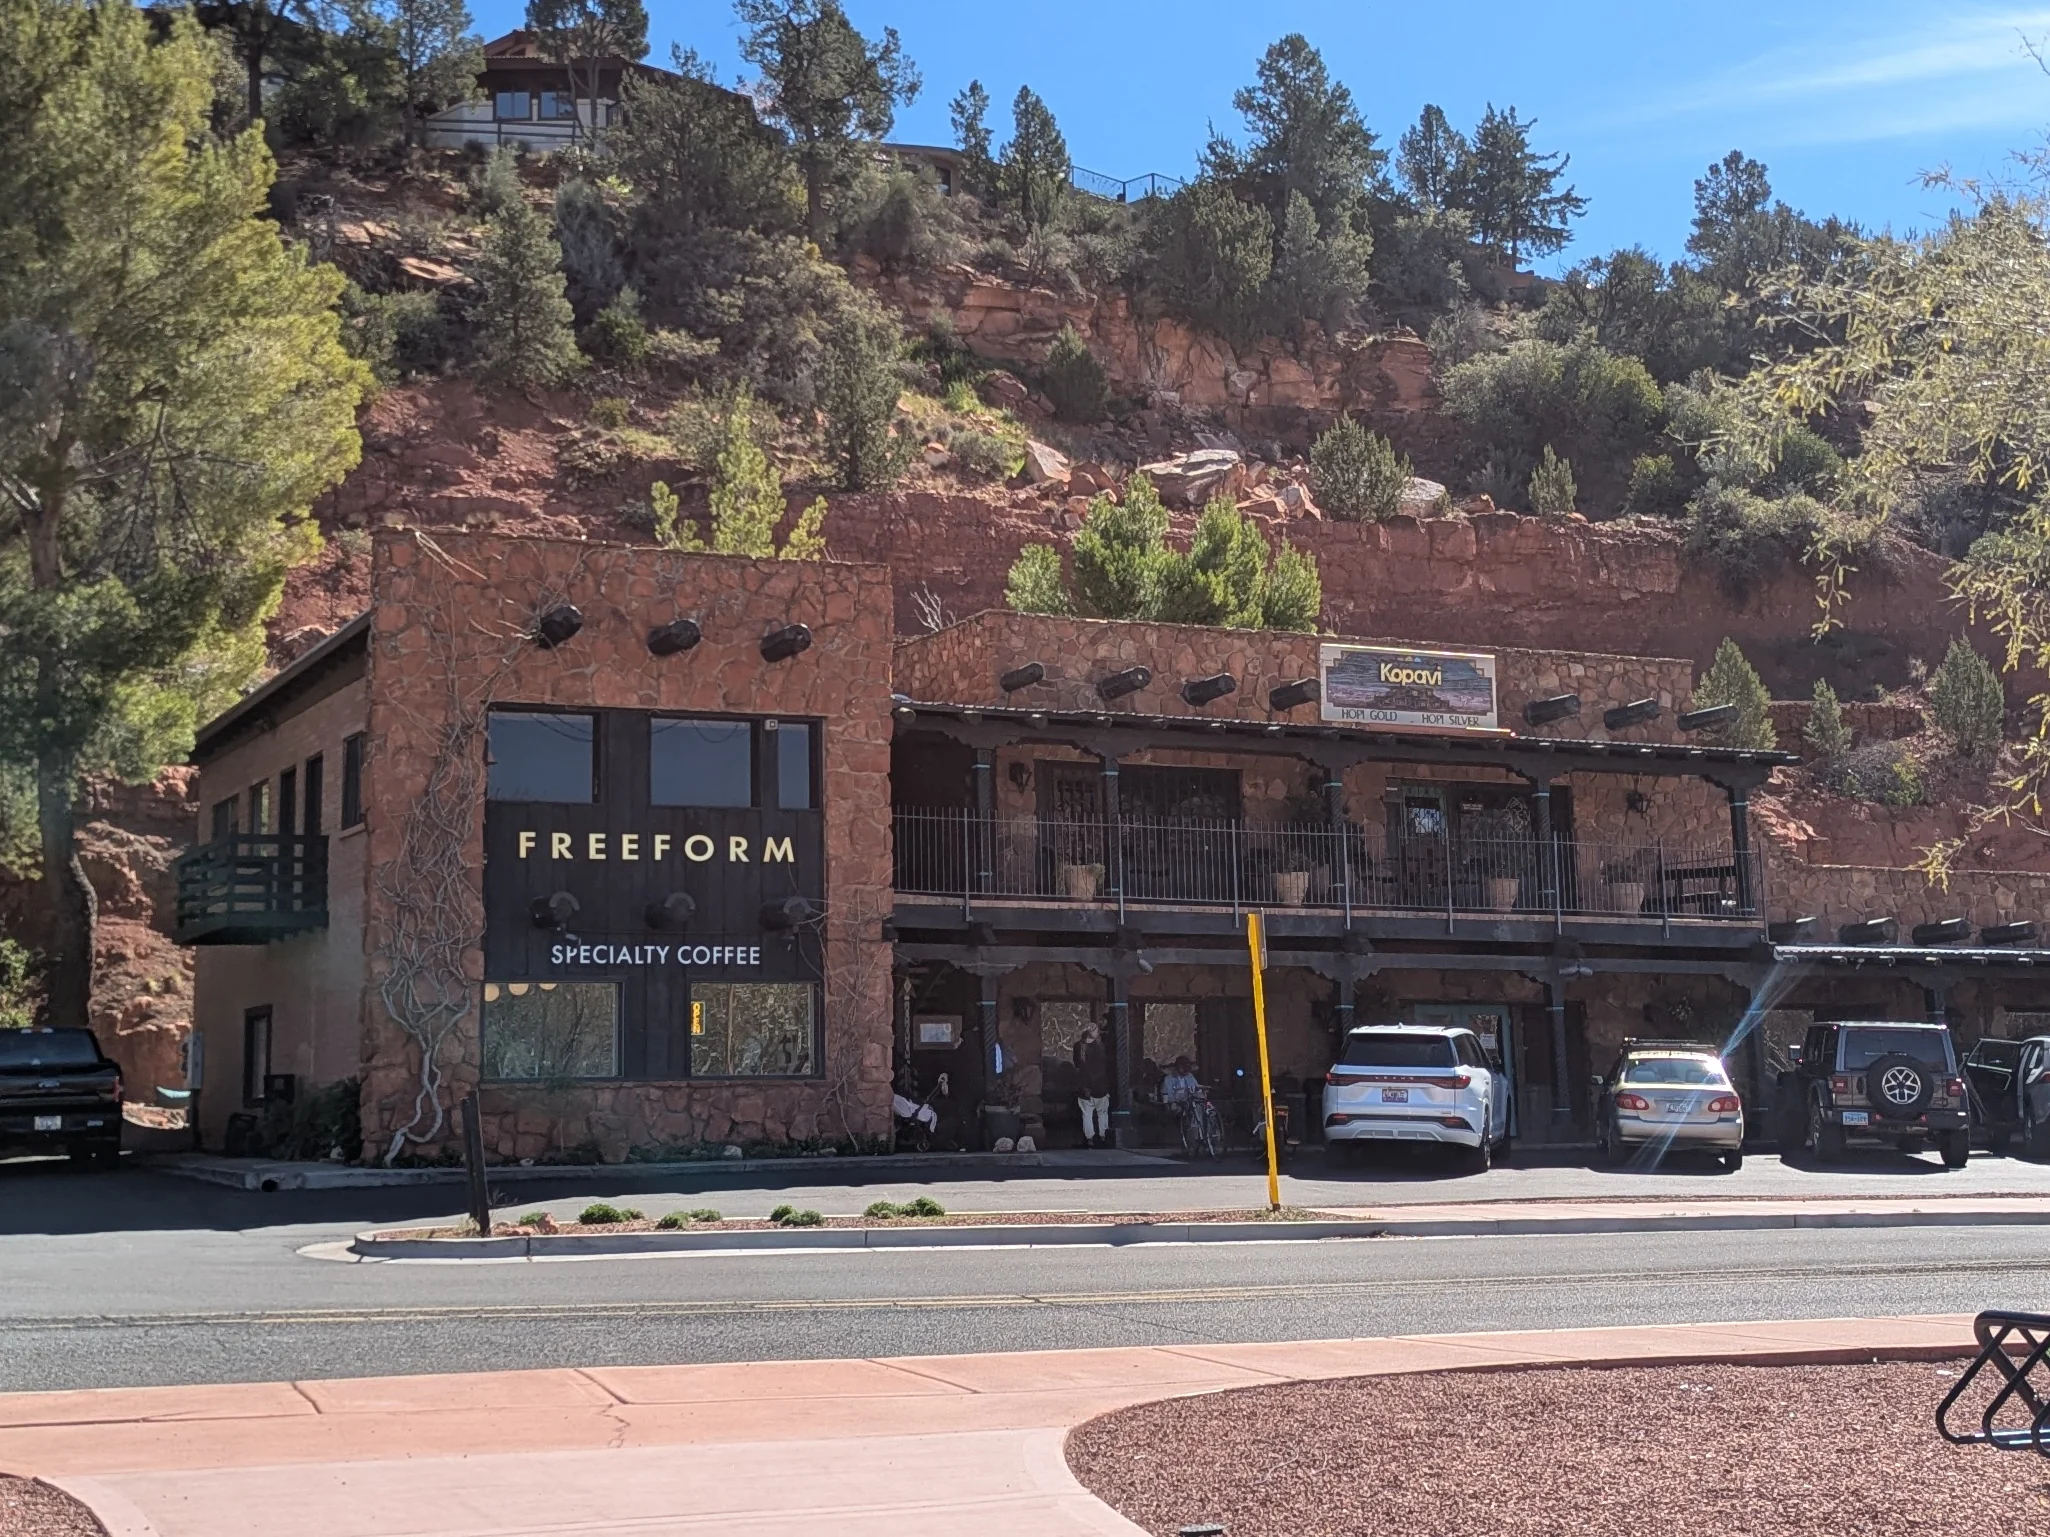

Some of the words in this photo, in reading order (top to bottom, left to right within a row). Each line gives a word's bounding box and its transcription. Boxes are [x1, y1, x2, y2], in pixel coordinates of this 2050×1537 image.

[1380, 662, 1442, 686] Kopavi
[1341, 708, 1365, 720] HOPI
[1369, 709, 1398, 721] GOLD
[1421, 713, 1444, 724] HOPI
[1448, 715, 1480, 727] SILVER
[518, 831, 795, 863] FREEFORM
[551, 944, 670, 965] SPECIALTY
[677, 945, 760, 965] COFFEE
